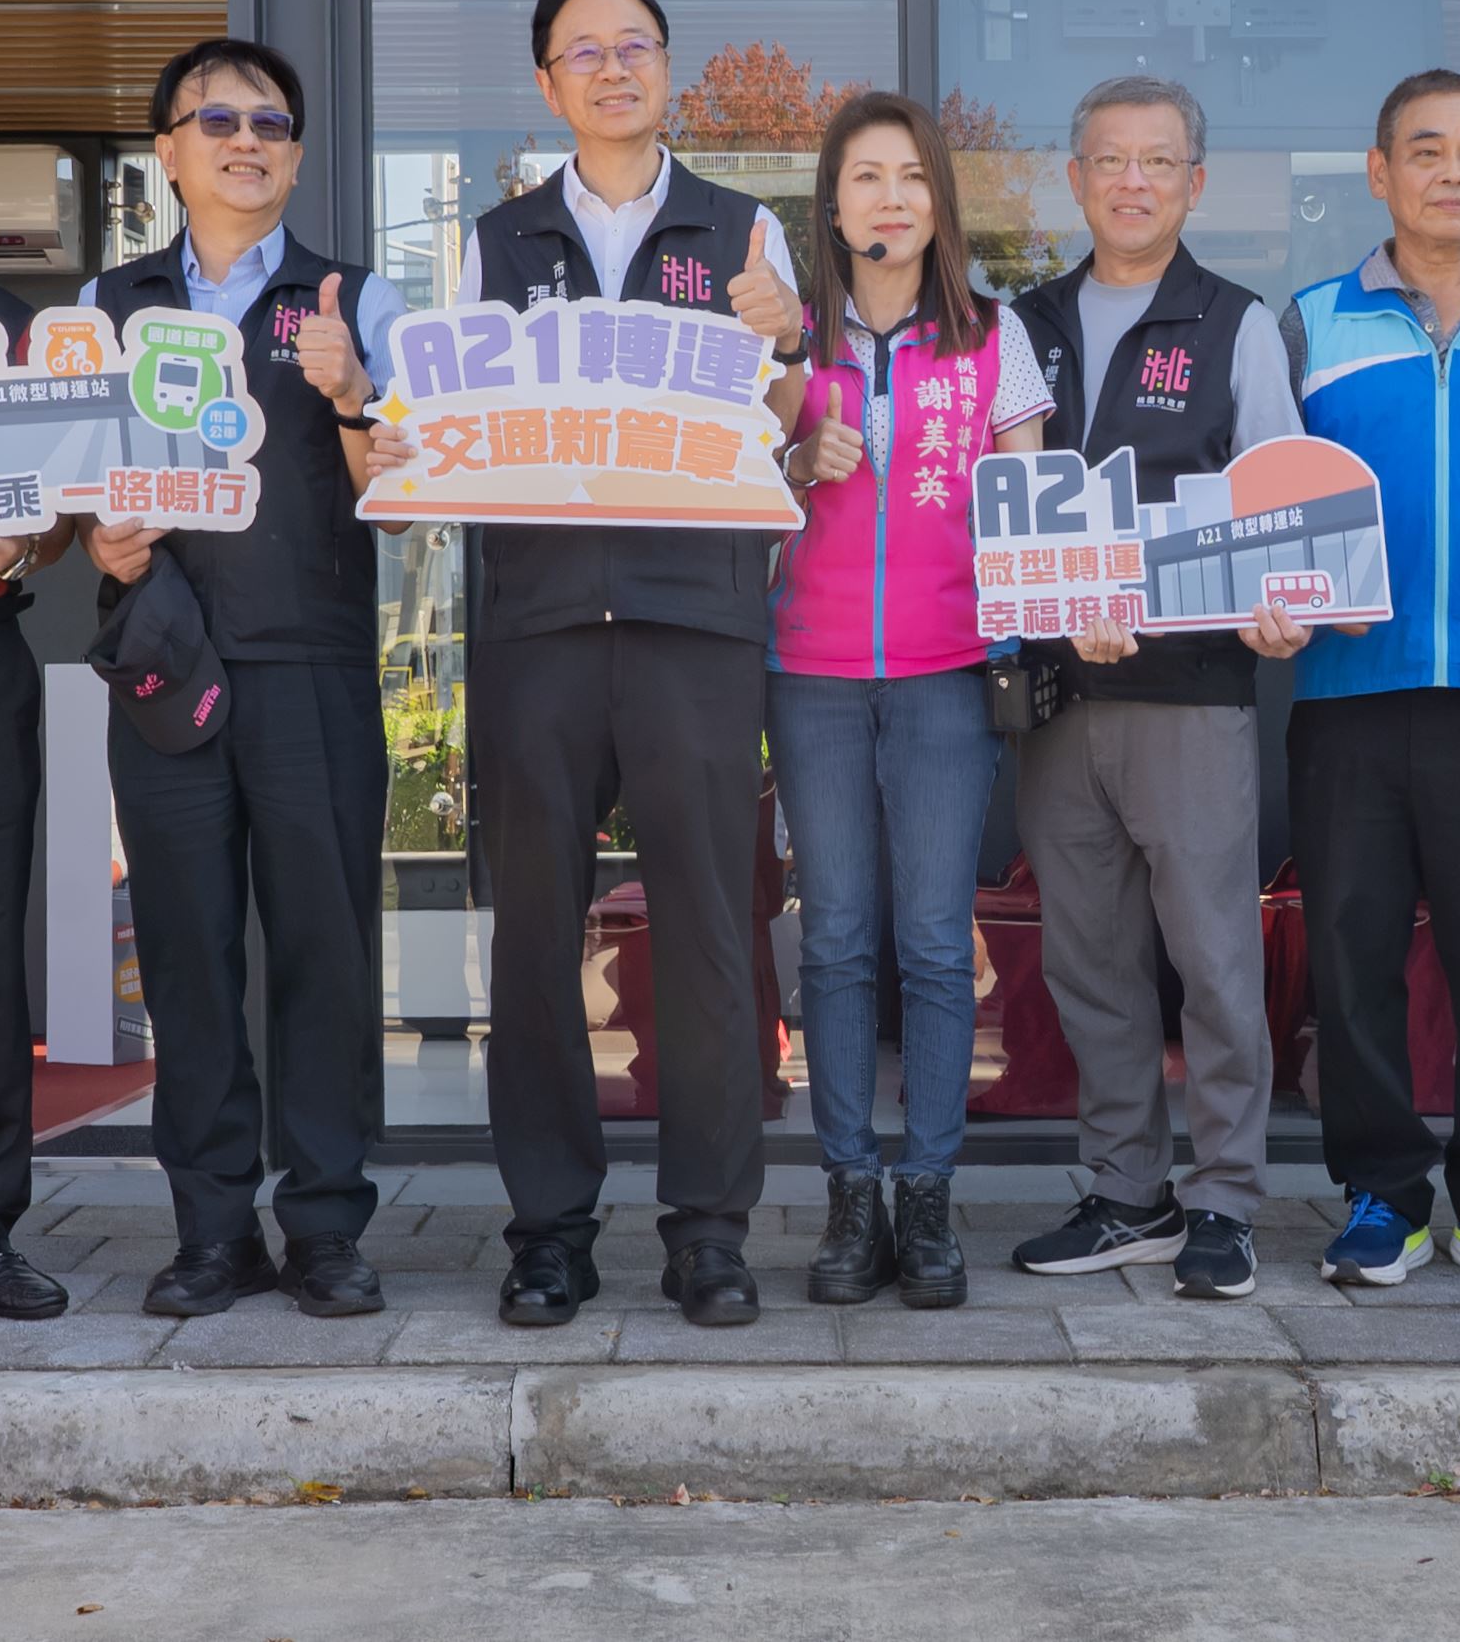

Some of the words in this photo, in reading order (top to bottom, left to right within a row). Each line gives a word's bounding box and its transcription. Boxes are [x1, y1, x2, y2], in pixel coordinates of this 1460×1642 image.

[400, 310, 767, 406] A21轉運
[418, 407, 743, 483] 交通新篇章
[910, 377, 955, 510] 謝美英
[954, 356, 977, 477] 桃園市議員
[62, 470, 246, 515] 一路暢行
[976, 446, 1135, 538] A21
[1196, 525, 1223, 546] A21
[1230, 507, 1304, 541] 微型轉運站
[978, 543, 1143, 587] 微型轉運
